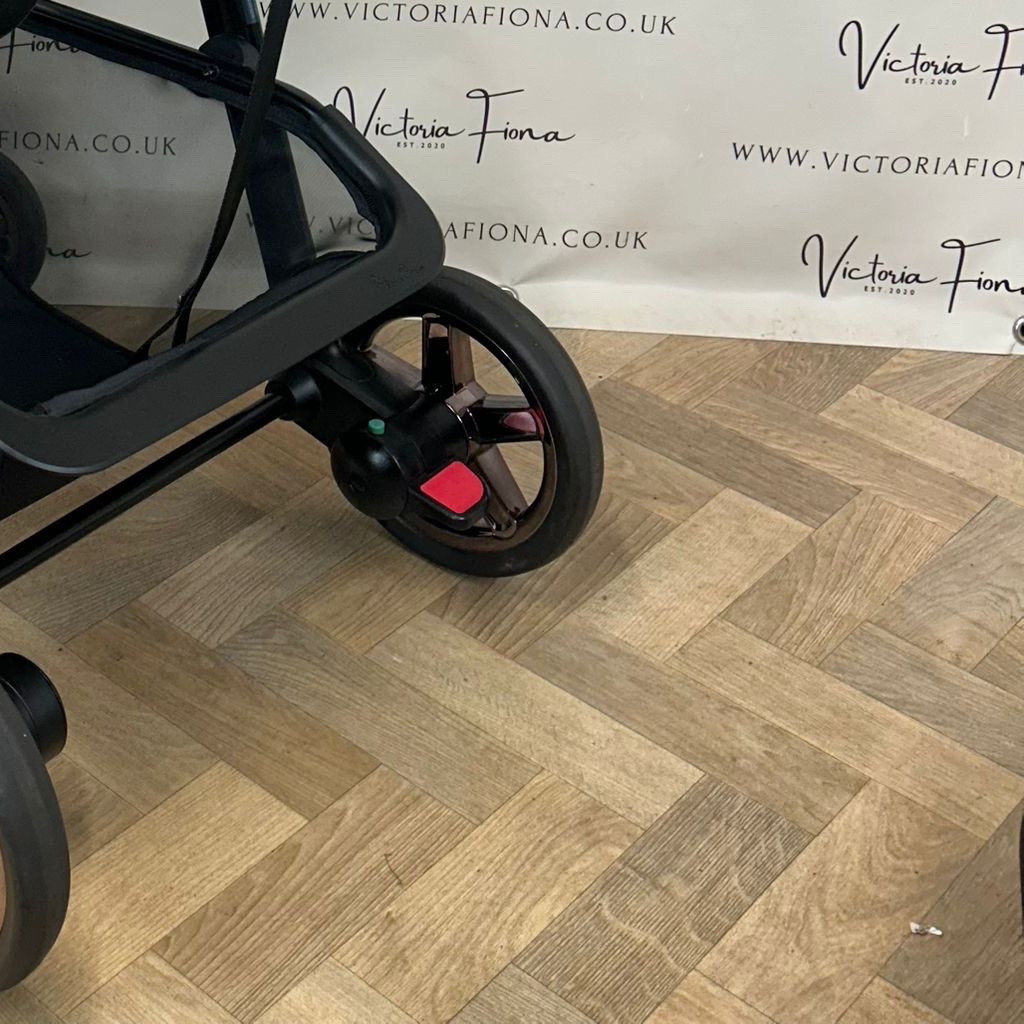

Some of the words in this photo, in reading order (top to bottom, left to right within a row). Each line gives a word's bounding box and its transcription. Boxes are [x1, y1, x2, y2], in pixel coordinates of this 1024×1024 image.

[838, 19, 981, 90] Victoria
[903, 77, 958, 86] EST.2020
[396, 141, 446, 150] EST.2020
[466, 88, 576, 163] Fiona
[801, 233, 937, 298] Victoria
[937, 238, 1024, 314] Fion
[863, 285, 916, 296] EST.2020
